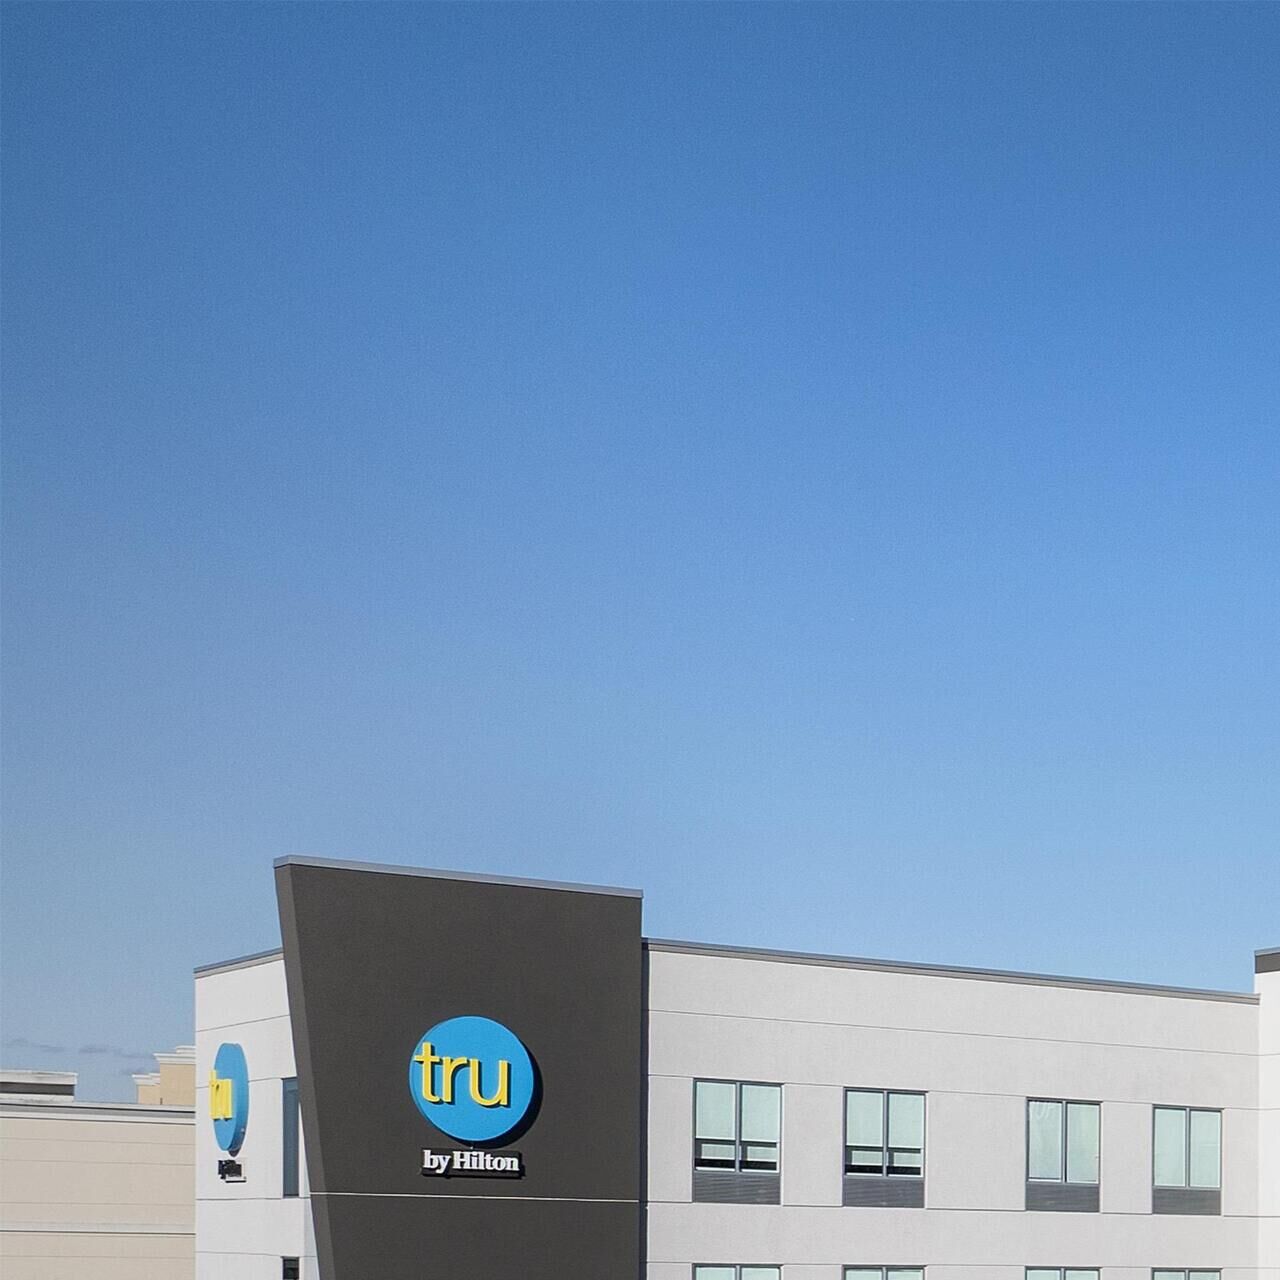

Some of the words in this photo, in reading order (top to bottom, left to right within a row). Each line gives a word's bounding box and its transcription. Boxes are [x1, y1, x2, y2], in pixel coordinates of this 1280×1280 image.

[414, 1041, 508, 1106] tru
[423, 1149, 451, 1174] by
[452, 1150, 520, 1171] Hilton
